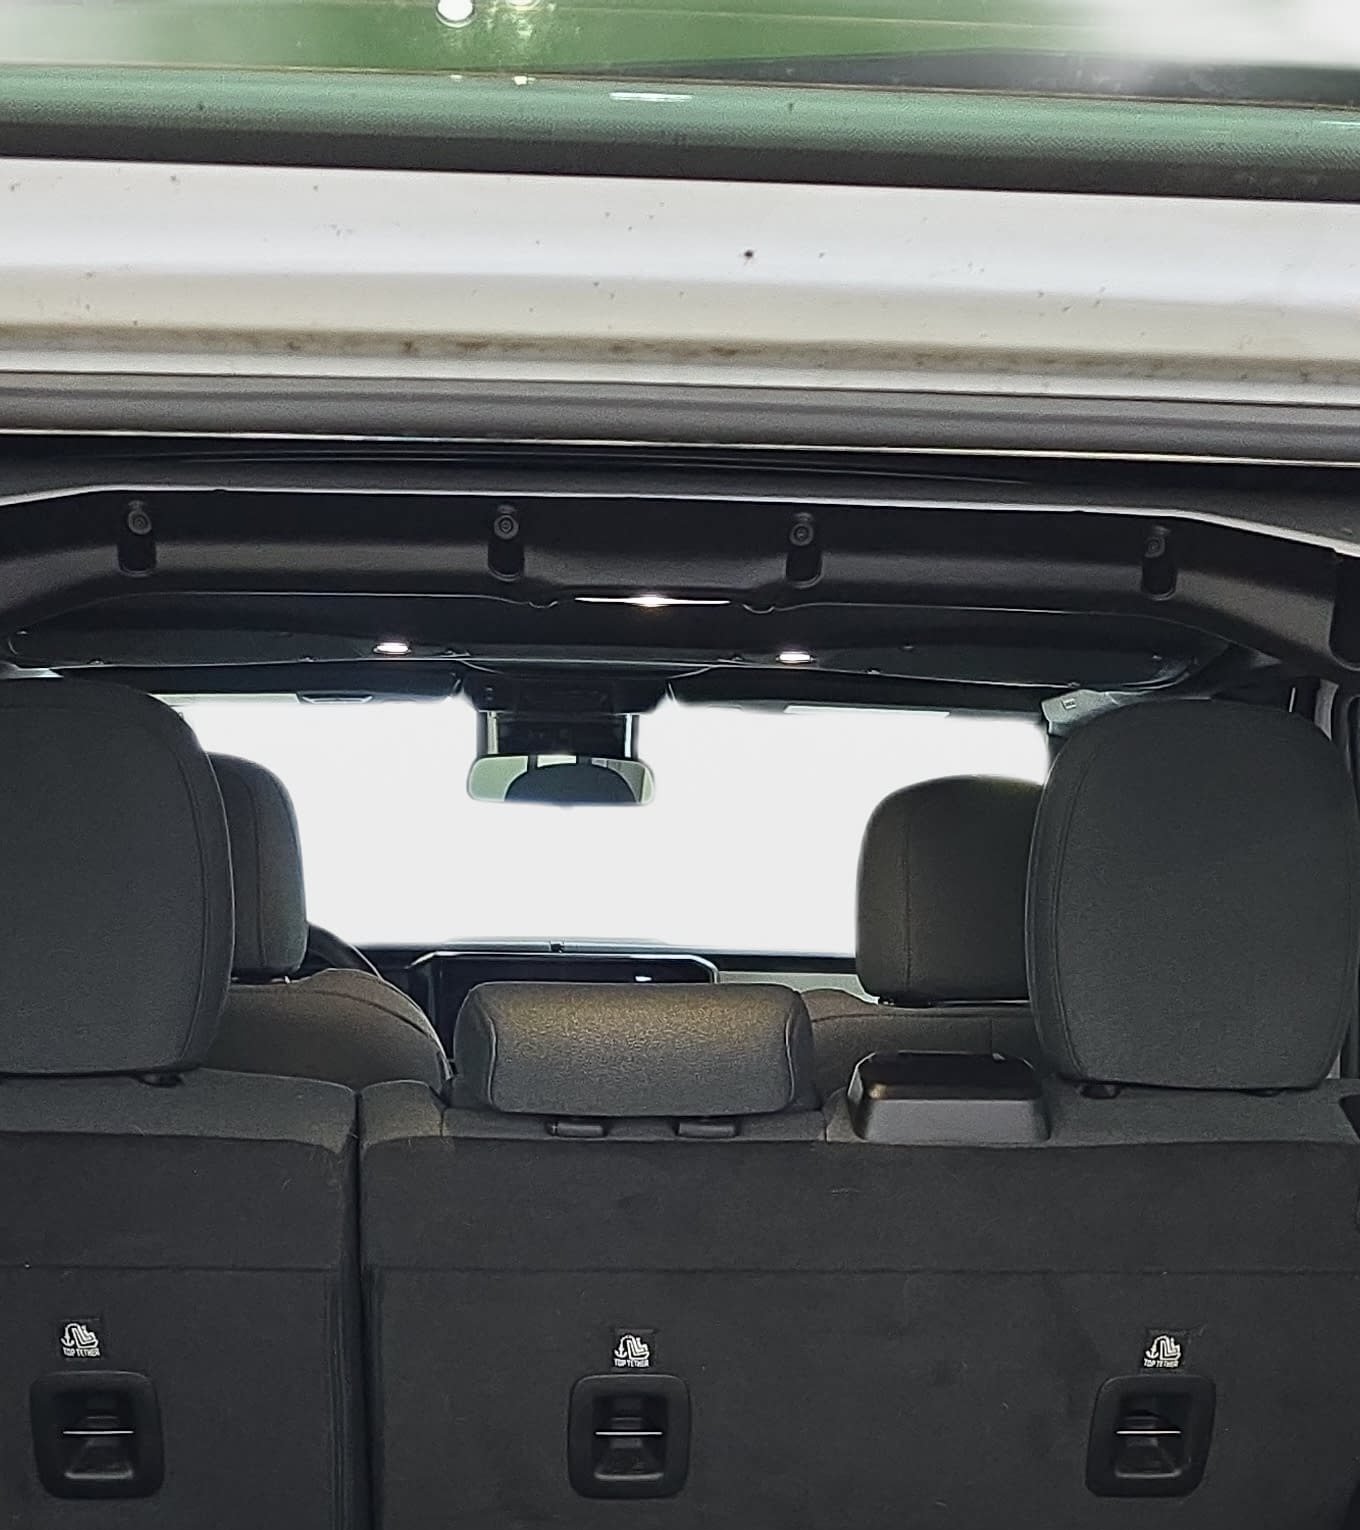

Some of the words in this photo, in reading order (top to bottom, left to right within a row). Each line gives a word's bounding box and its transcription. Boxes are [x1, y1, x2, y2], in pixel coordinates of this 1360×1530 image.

[62, 1347, 75, 1357] TOP
[76, 1347, 100, 1357] TETHER
[614, 1358, 626, 1367] TOP
[627, 1358, 649, 1367] TETHER
[1143, 1359, 1156, 1368] TOP
[1156, 1360, 1179, 1368] TETHER
